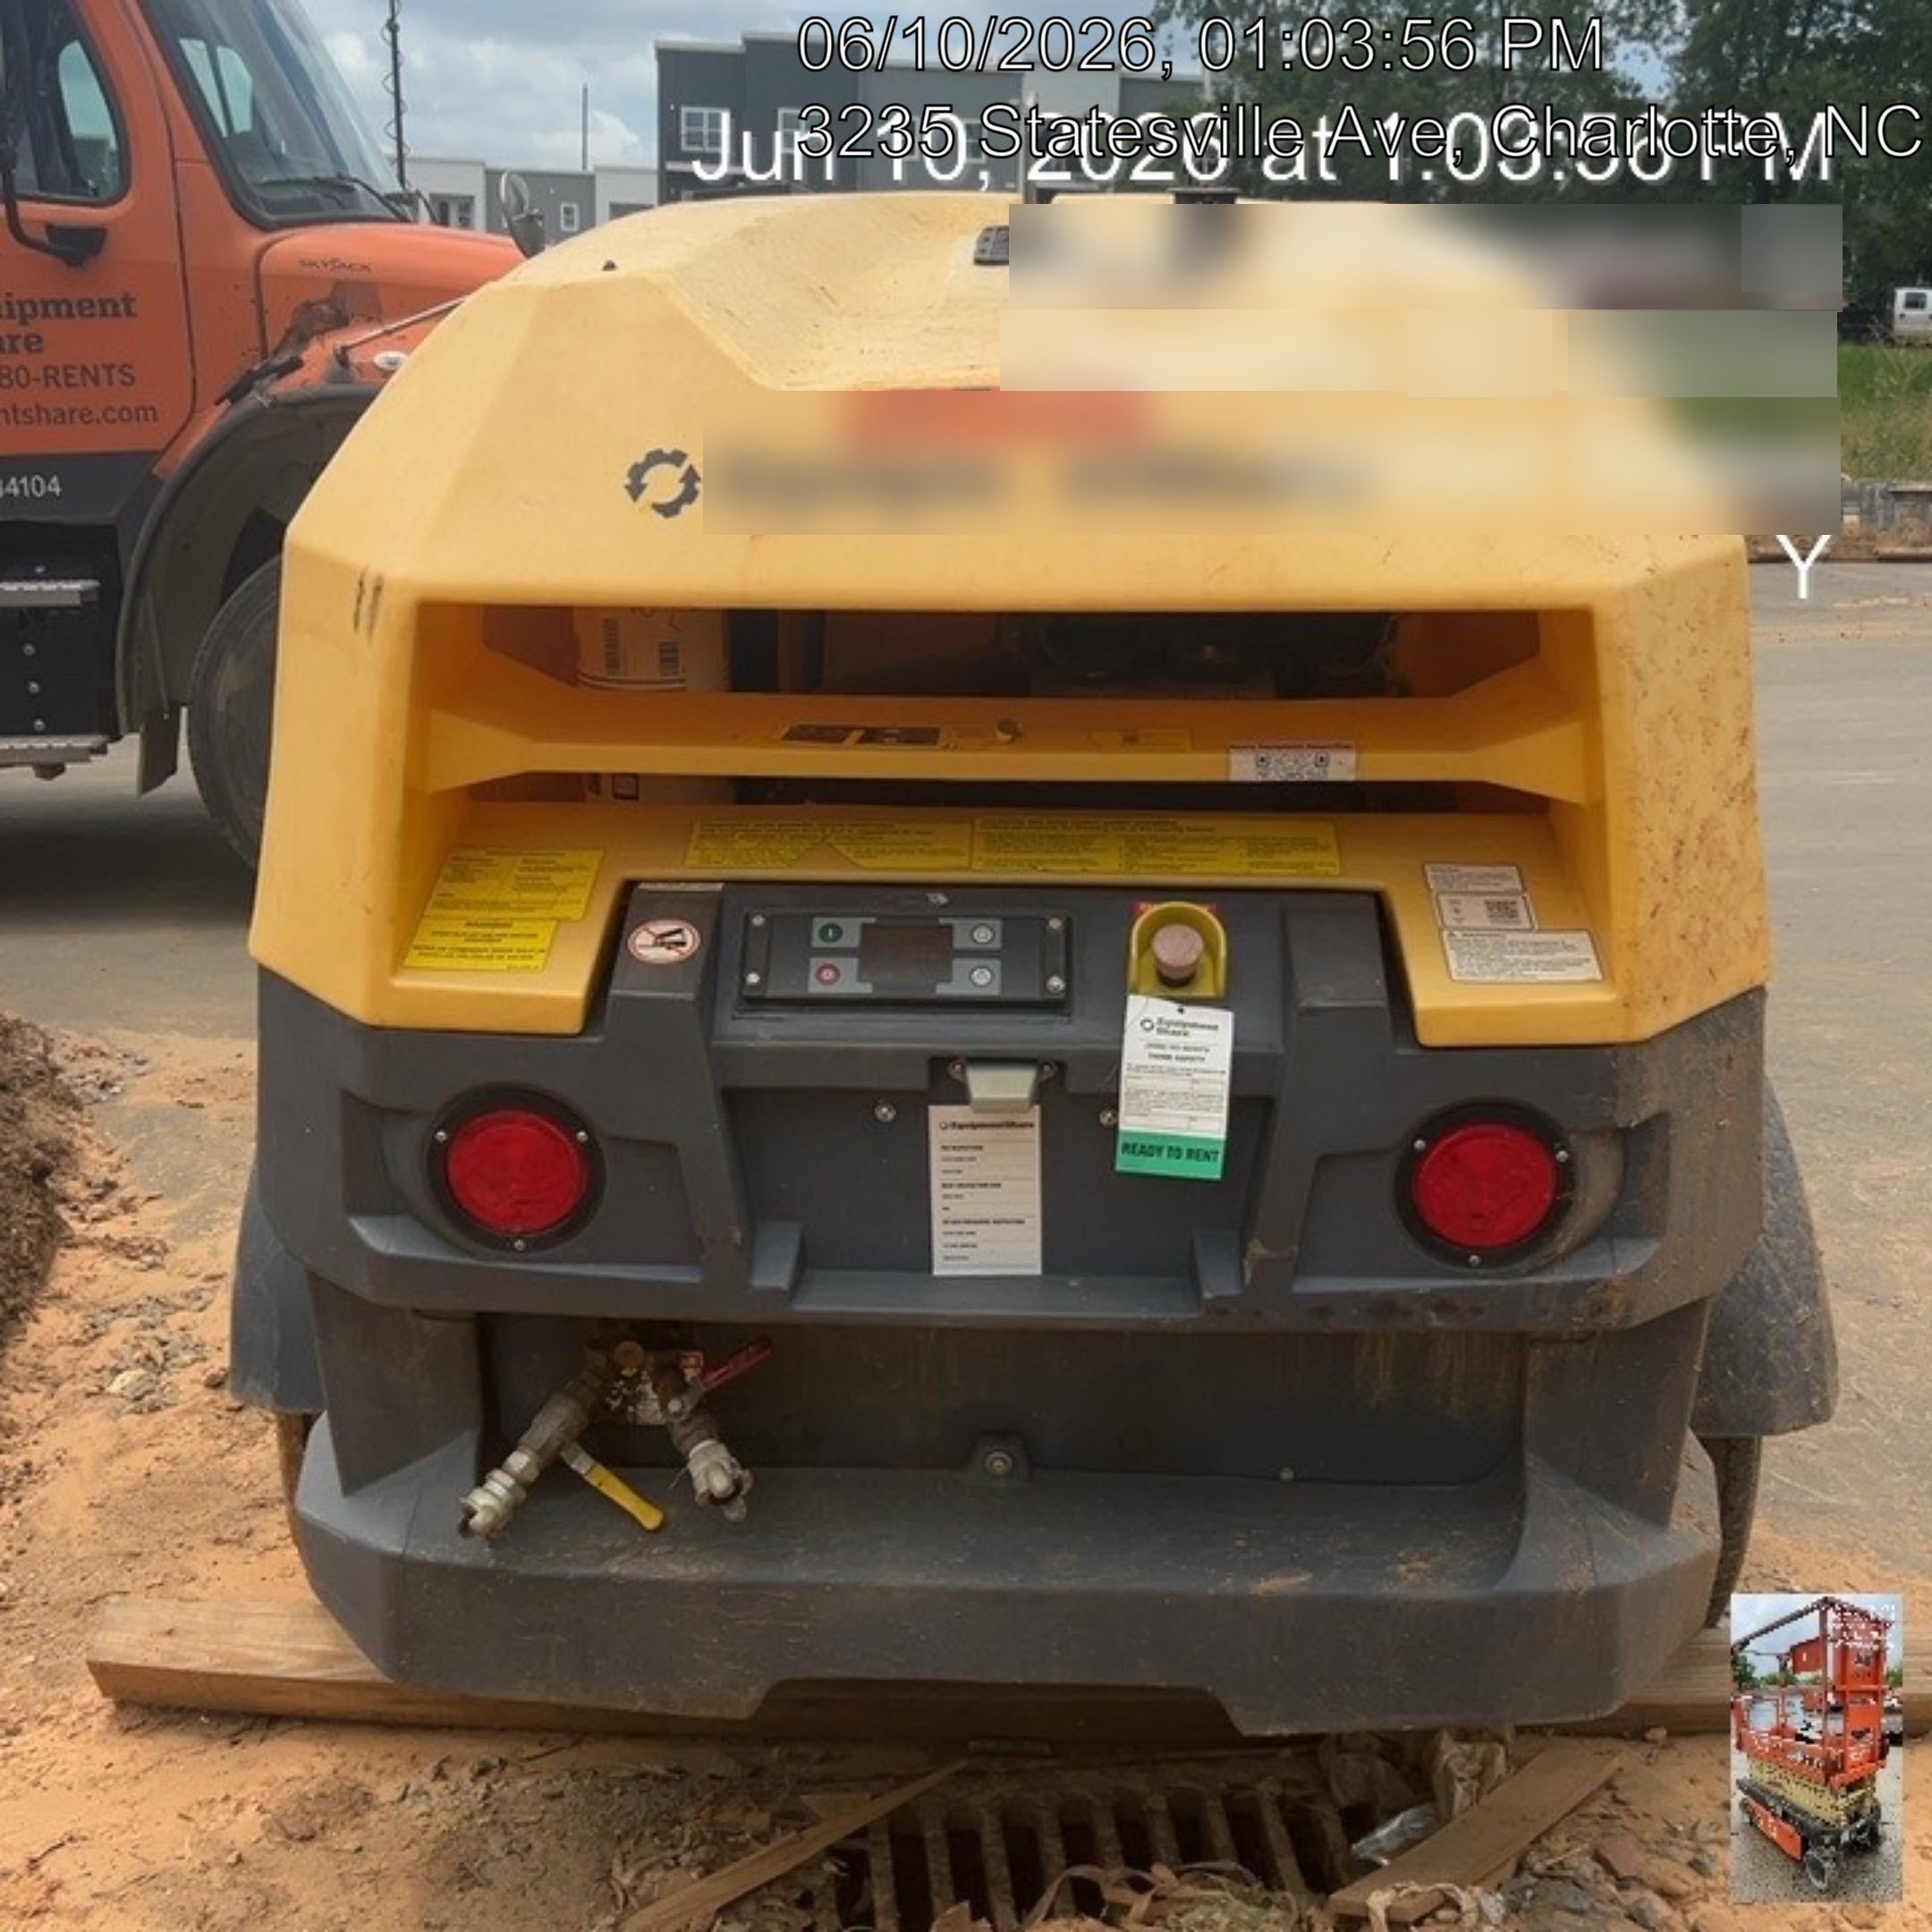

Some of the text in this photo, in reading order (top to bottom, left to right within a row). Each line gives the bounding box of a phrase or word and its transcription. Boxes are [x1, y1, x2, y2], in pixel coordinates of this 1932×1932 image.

[0, 292, 137, 325] ipment
[0, 474, 63, 497] 4104
[1121, 1142, 1219, 1163] READY TO RENT
